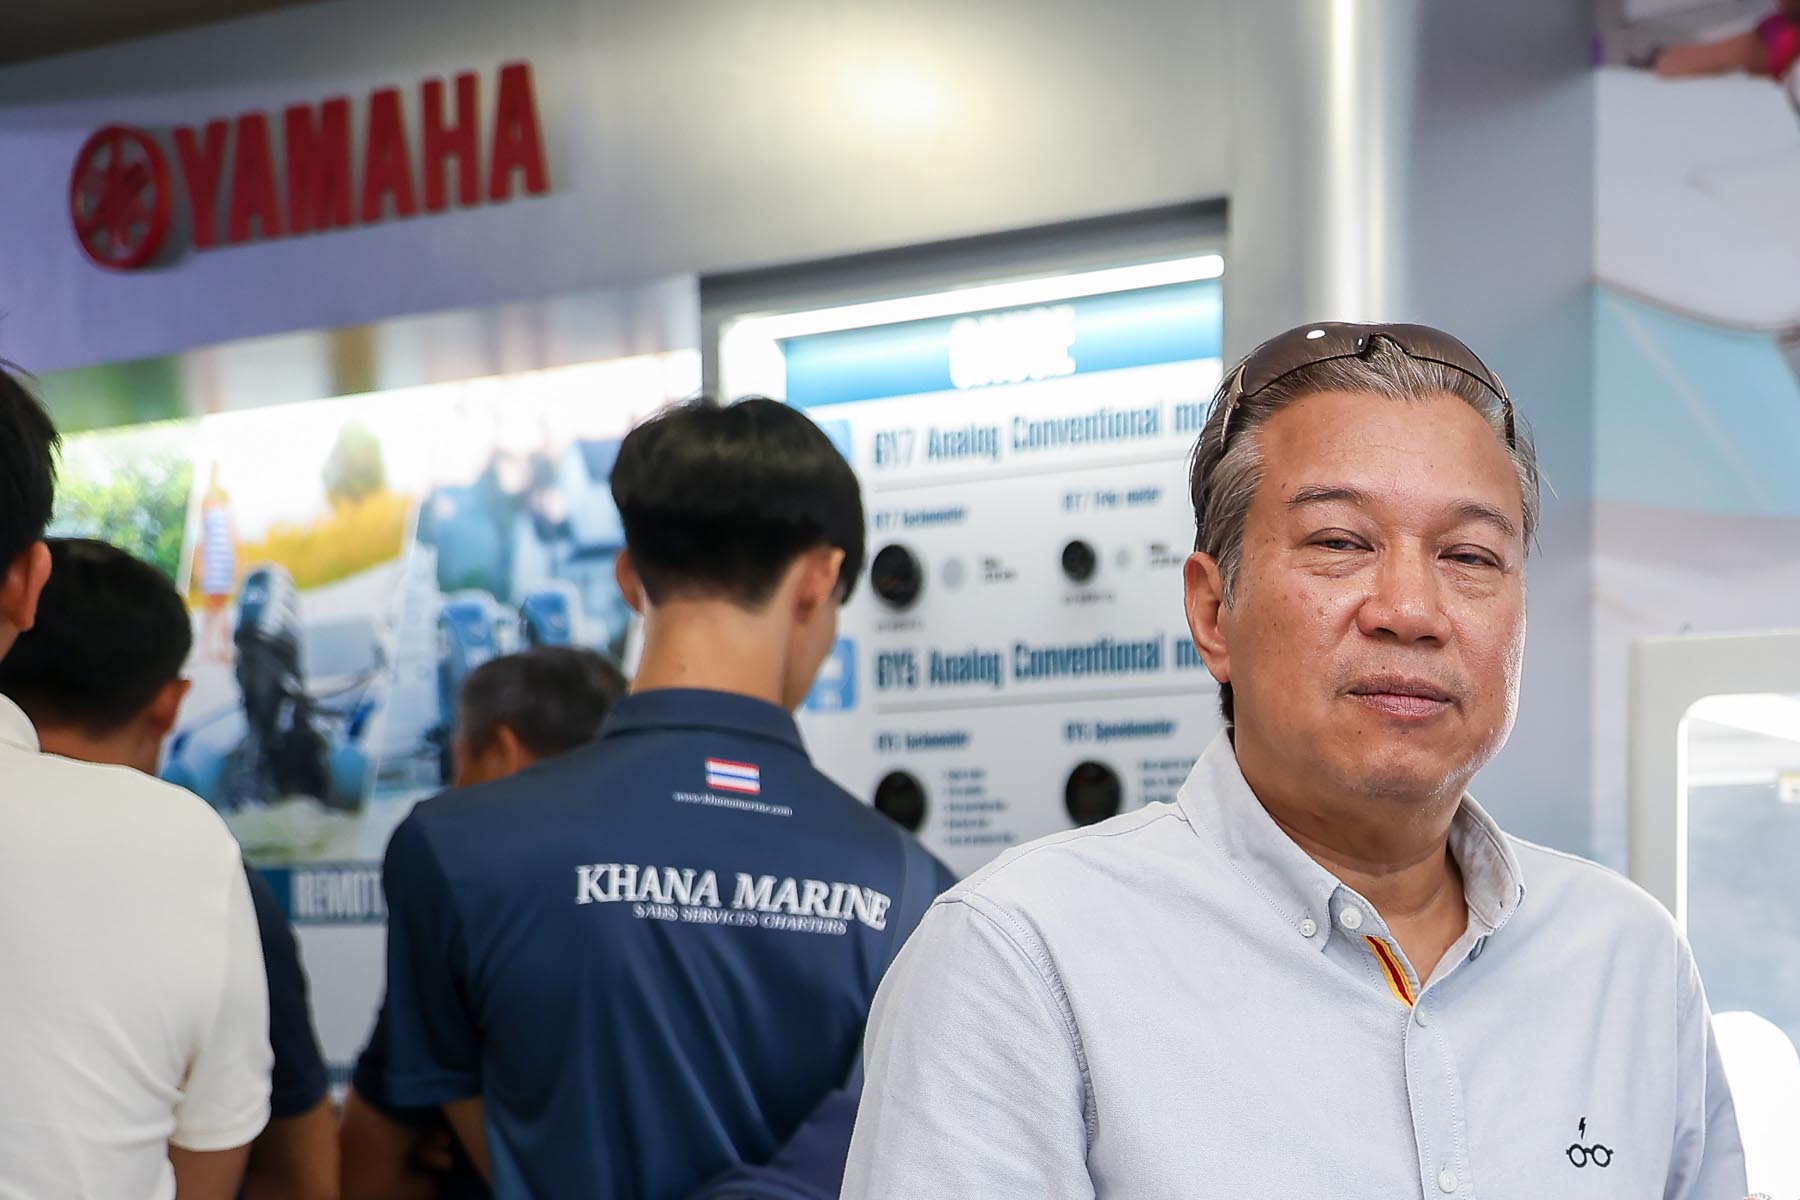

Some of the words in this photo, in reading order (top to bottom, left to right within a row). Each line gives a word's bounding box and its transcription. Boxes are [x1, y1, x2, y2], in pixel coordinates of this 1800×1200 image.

[174, 58, 549, 251] YAMAHA
[927, 423, 999, 461] Analog
[1012, 402, 1161, 450] Conventional
[928, 645, 1001, 687] Analog
[1013, 635, 1164, 681] Conventional
[575, 863, 722, 907] KHANA
[731, 872, 892, 931] MARINE
